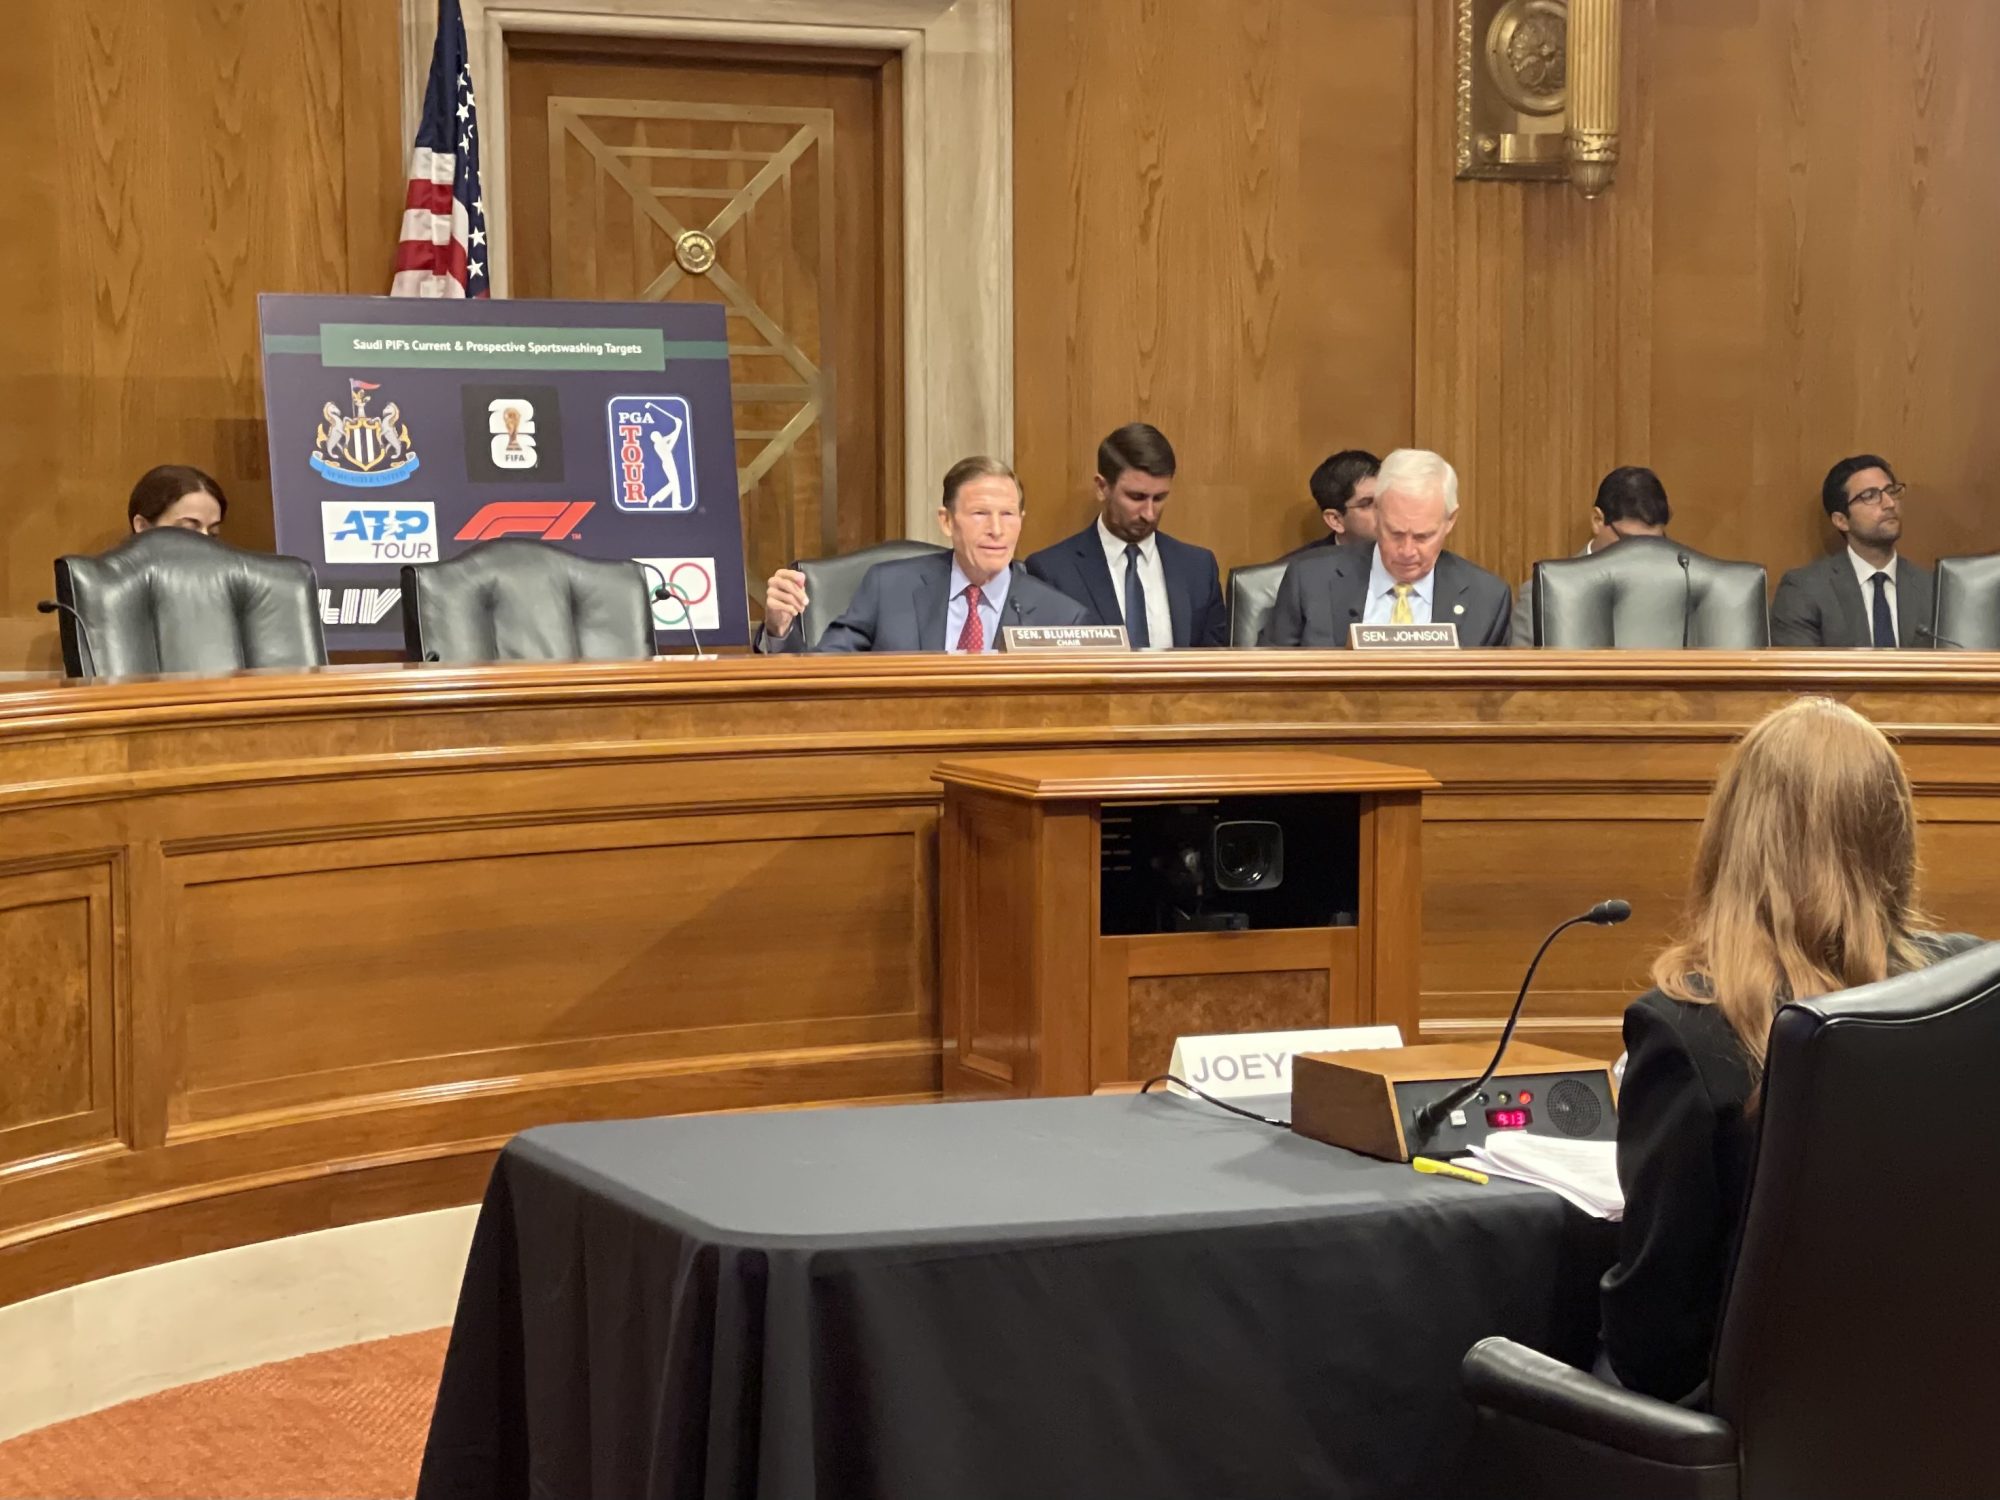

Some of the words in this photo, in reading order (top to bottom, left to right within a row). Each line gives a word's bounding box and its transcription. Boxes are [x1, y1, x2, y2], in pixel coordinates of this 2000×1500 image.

[353, 339, 382, 350] Saudi
[385, 340, 410, 351] PIF's
[411, 340, 451, 352] Current
[454, 341, 463, 351] &
[466, 341, 525, 354] Prospective
[528, 341, 603, 356] Sportswashing
[604, 342, 642, 356] Targets
[618, 412, 655, 424] PGA
[505, 454, 526, 462] FIFA
[619, 425, 648, 503] TOUR
[329, 510, 430, 541] ATP
[571, 532, 582, 540] TM
[371, 542, 432, 559] TOUR
[318, 588, 402, 625] LIV
[1017, 629, 1042, 640] SEN.
[1044, 628, 1117, 640] BLUMENTHAL
[1362, 631, 1388, 641] SEN.
[1393, 630, 1449, 641] JOHNSON
[1192, 1052, 1286, 1084] JOEY
